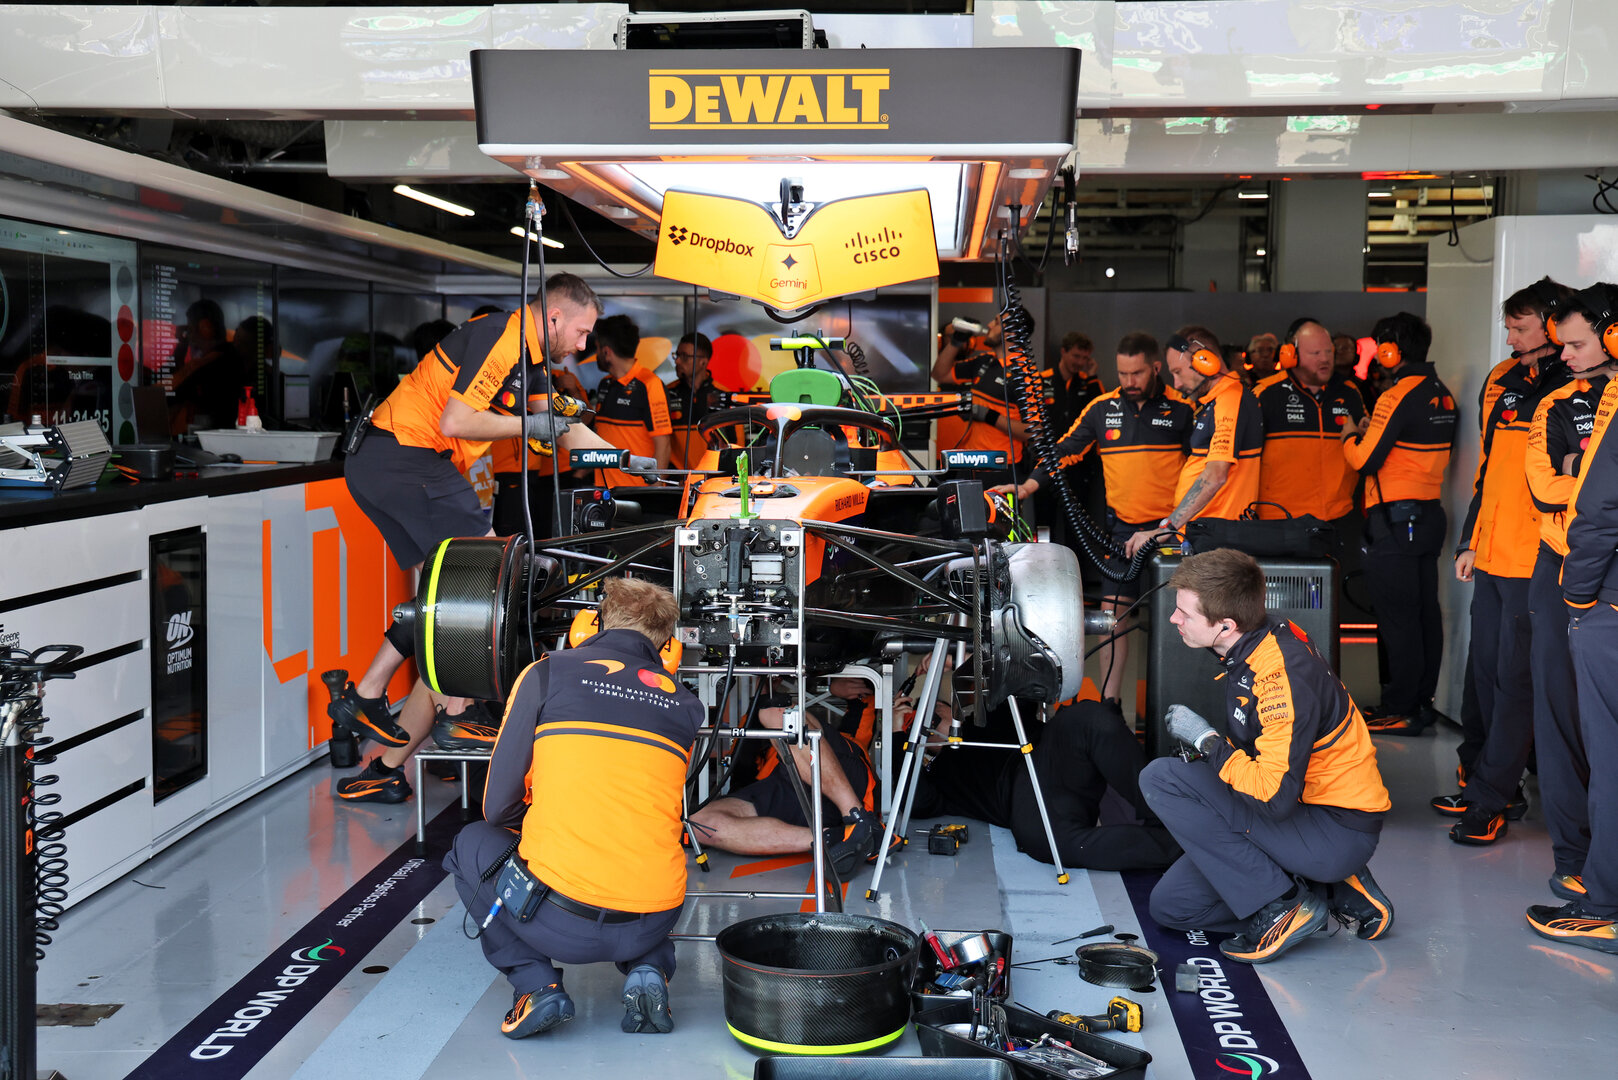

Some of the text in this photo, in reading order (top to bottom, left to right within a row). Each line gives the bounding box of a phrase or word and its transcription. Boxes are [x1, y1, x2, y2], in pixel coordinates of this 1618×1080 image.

[690, 232, 755, 257] Dropbox
[853, 246, 900, 264] CISCO
[770, 278, 808, 290] Gemini
[482, 370, 500, 388] okta
[582, 451, 618, 465] allwyn
[949, 453, 988, 466] allwyn
[835, 492, 865, 512] RICHARD MILLE
[166, 611, 193, 642] ON
[0, 631, 20, 643] Greene
[167, 647, 192, 664] OPTIMUM
[167, 659, 192, 675] NUTRITION
[582, 679, 680, 706] McLAREN MASTERCARD
[594, 688, 635, 700] FORMULA
[649, 699, 670, 709] TEAM
[1260, 702, 1287, 714] ECOLAB
[732, 728, 745, 737] R1
[336, 858, 425, 927] Official Logistics Partner
[189, 964, 321, 1060] DP WORLD
[1186, 957, 1258, 1049] DP WORLD
